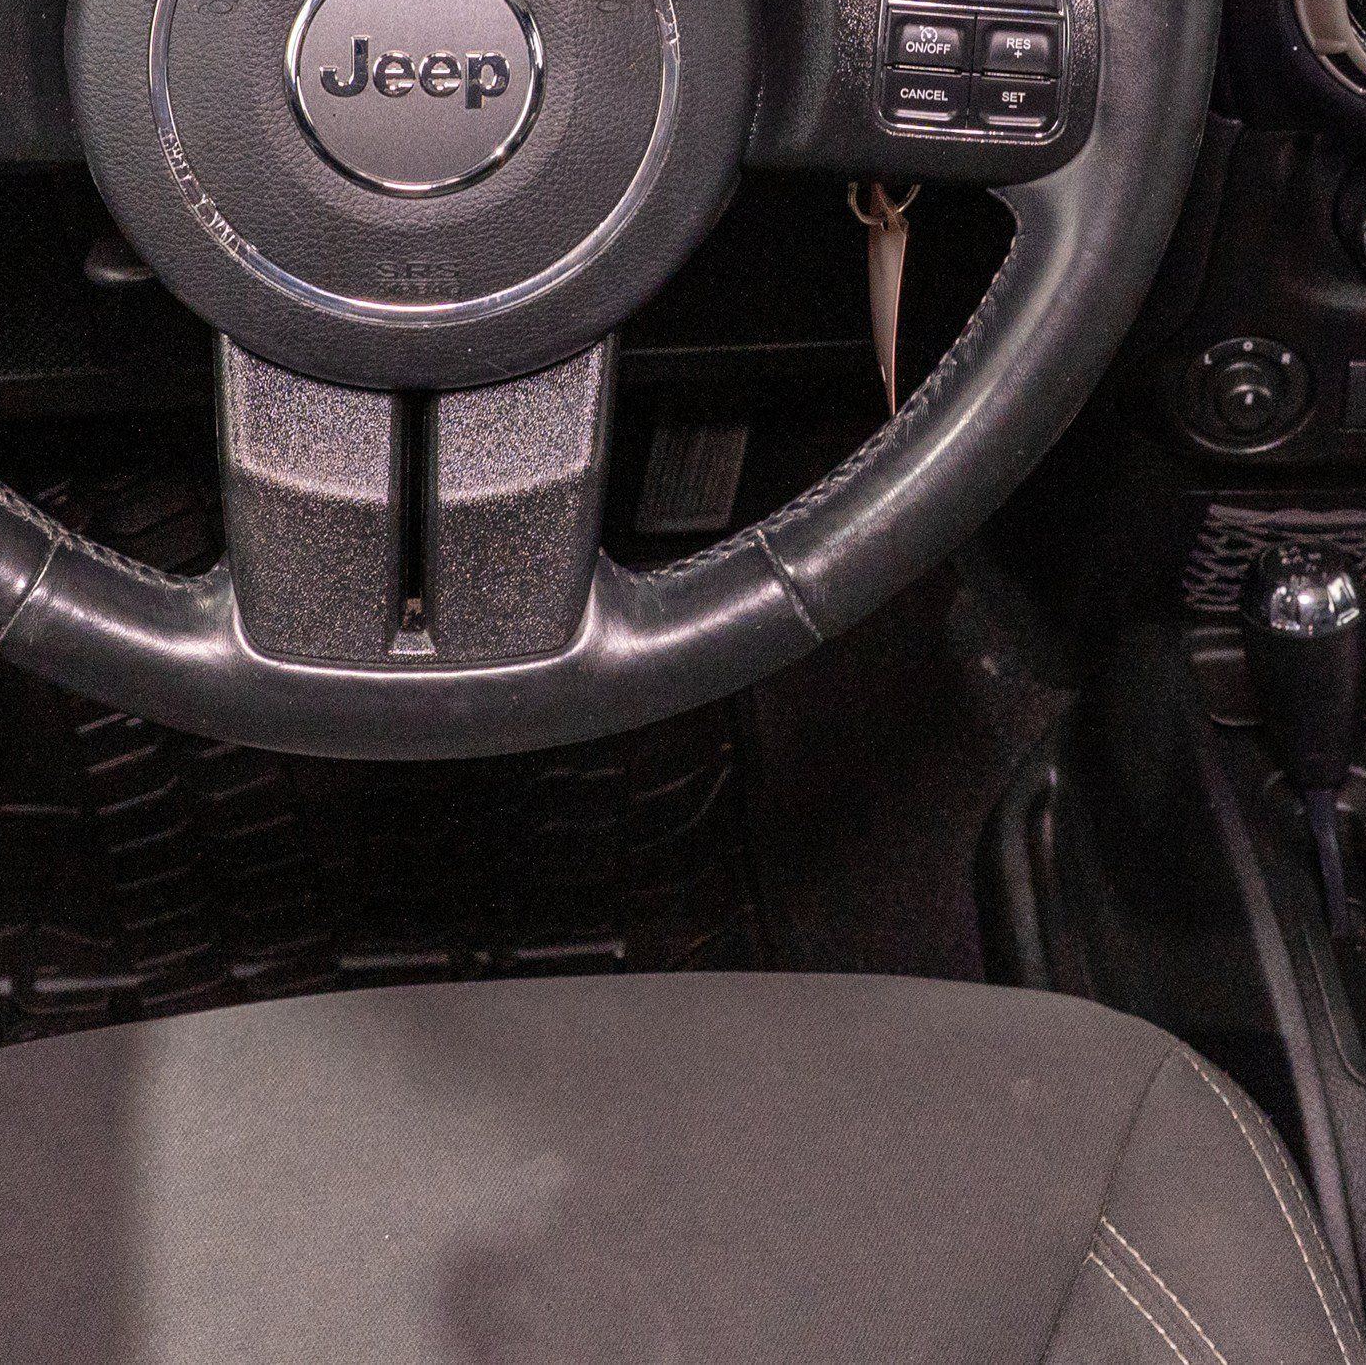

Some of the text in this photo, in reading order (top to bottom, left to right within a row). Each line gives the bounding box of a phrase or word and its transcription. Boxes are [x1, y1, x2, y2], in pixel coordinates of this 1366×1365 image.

[905, 41, 951, 55] ON/OFF
[1006, 37, 1031, 50] RES
[319, 35, 511, 109] Jeep
[900, 87, 948, 102] CANCEL
[1001, 91, 1026, 103] SET
